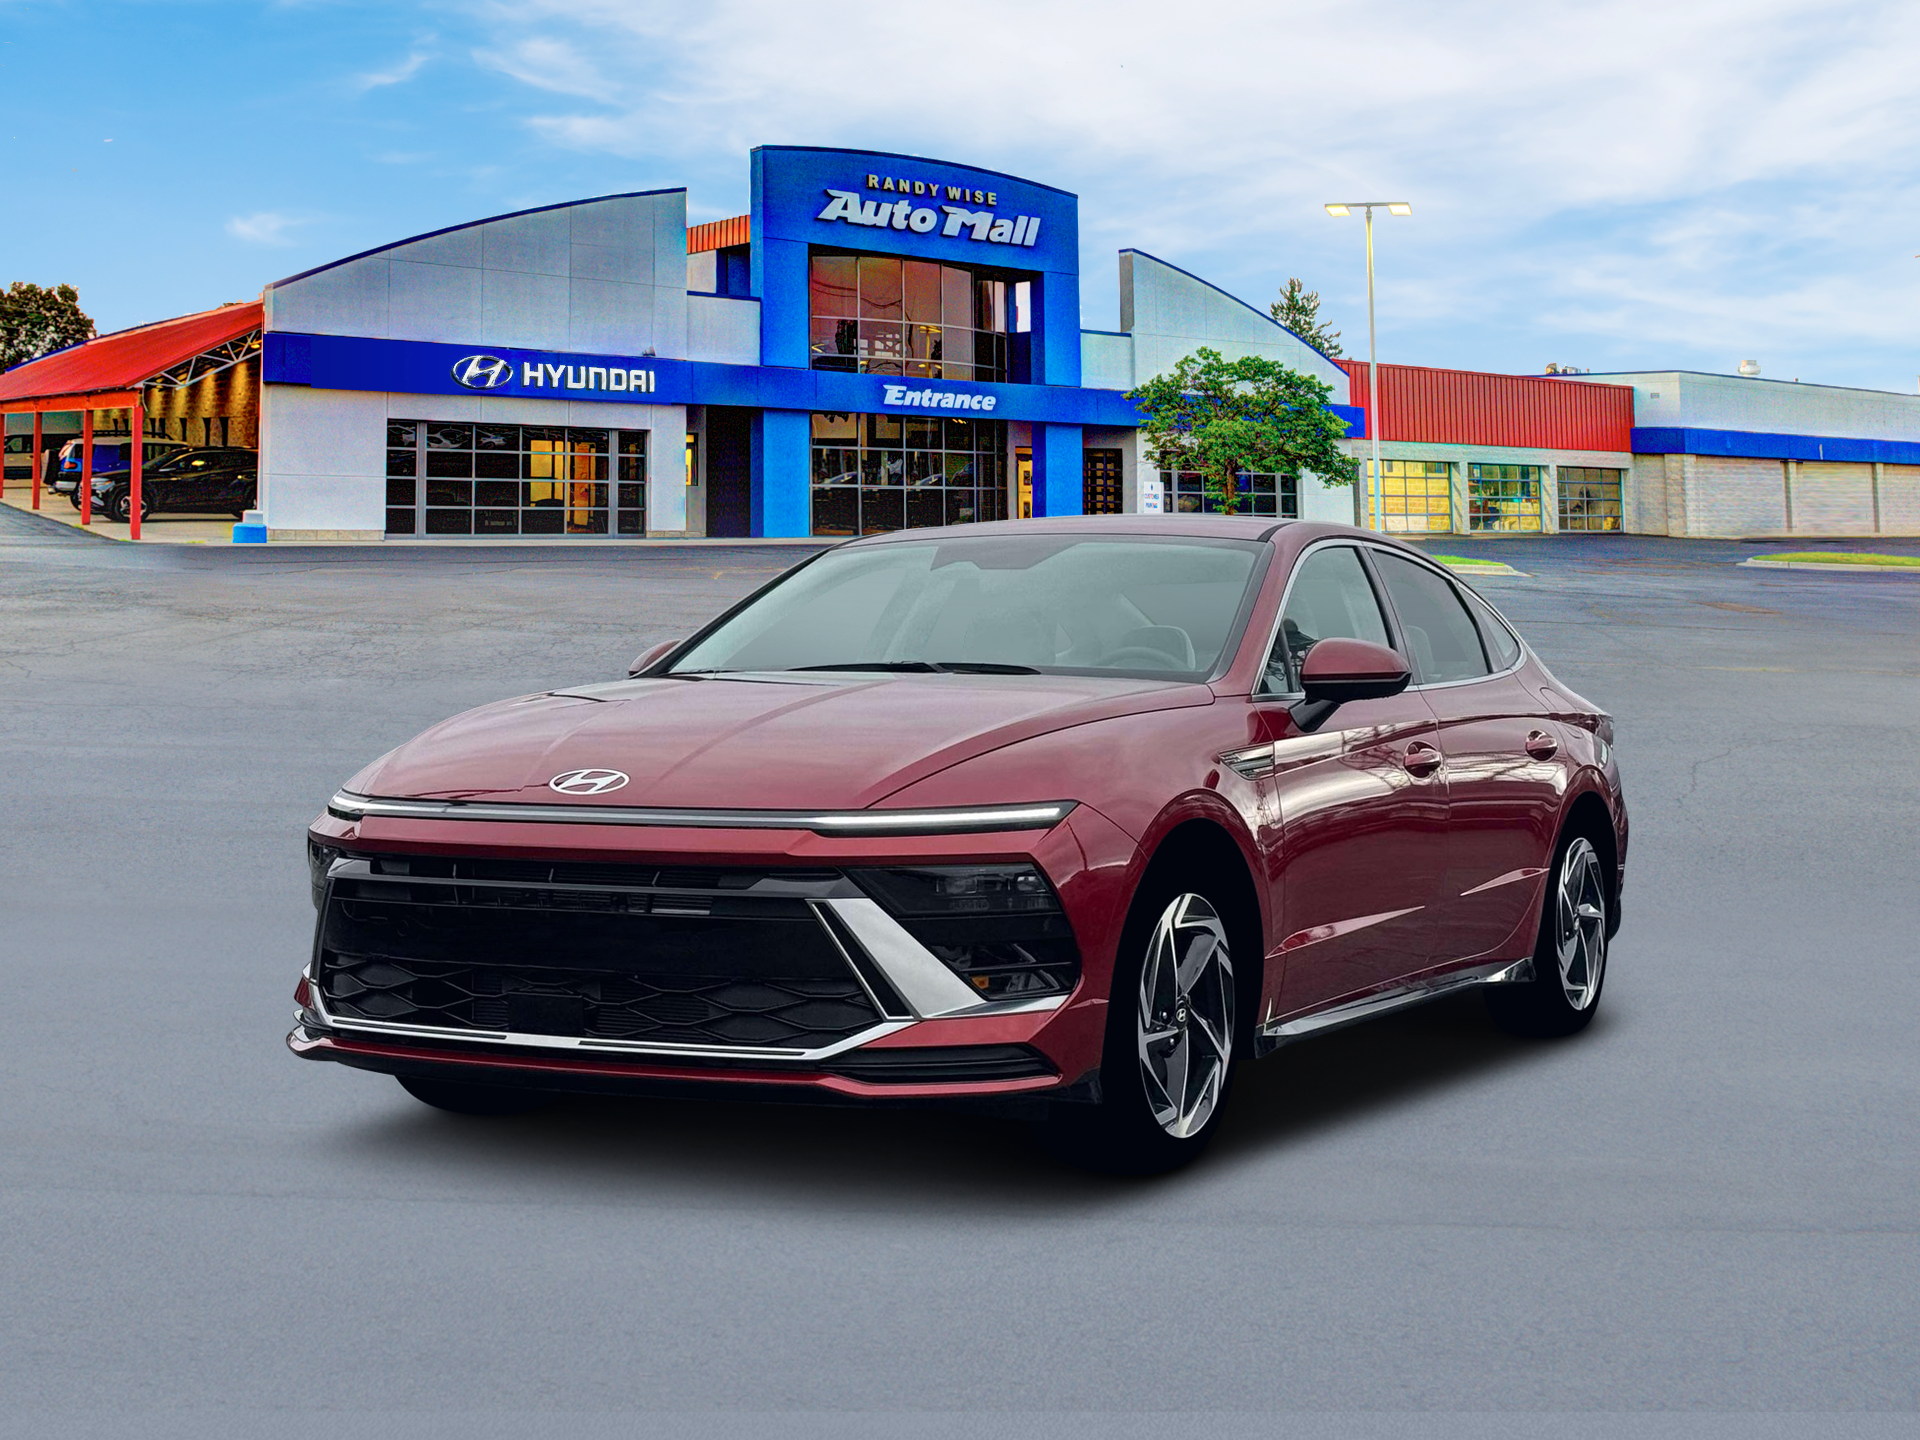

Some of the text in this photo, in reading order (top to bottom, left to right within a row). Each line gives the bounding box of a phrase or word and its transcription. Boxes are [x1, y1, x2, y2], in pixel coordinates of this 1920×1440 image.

[867, 174, 998, 206] RANDY WISE
[817, 189, 1041, 247] Auto Mall
[522, 361, 656, 393] HYUNDAI
[883, 384, 996, 411] Entrance
